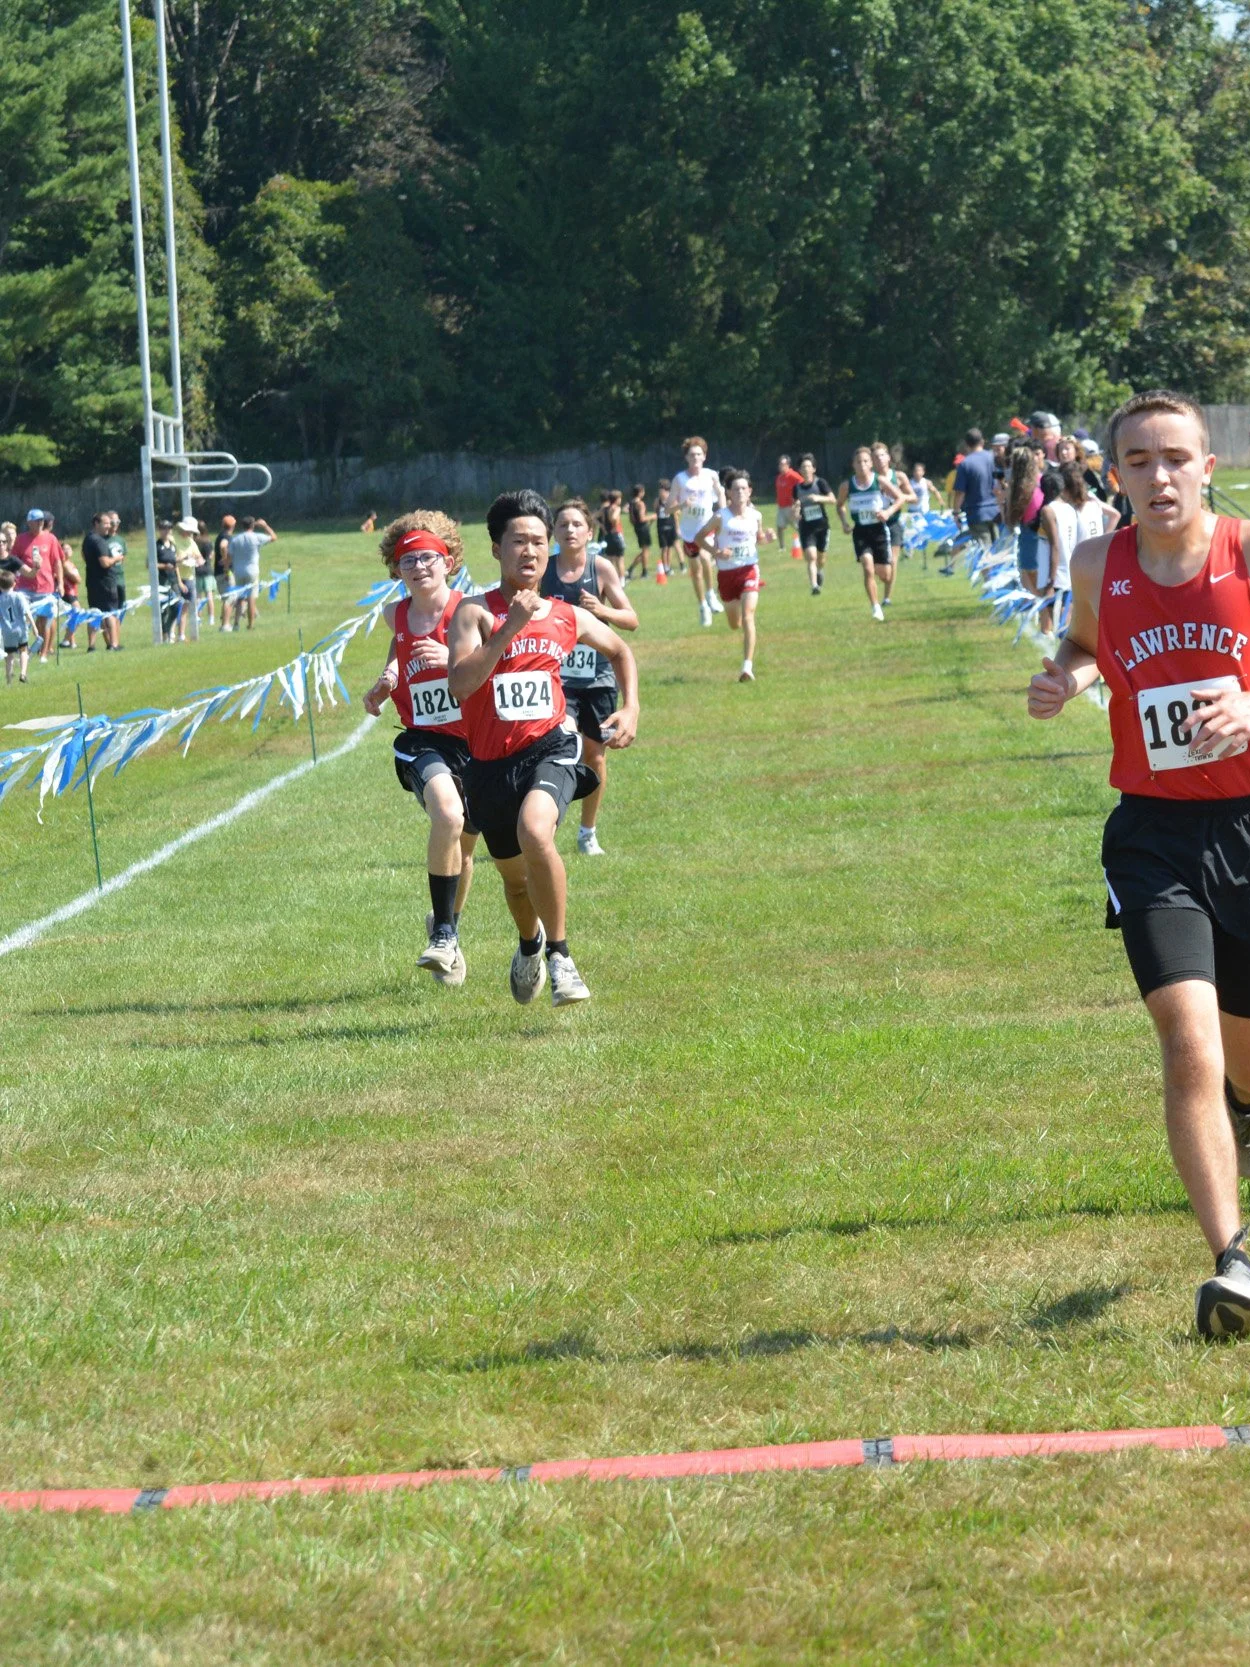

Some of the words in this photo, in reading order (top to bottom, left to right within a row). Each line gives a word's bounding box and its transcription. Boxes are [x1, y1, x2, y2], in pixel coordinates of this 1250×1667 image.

[7, 606, 14, 622] 1
[1115, 622, 1248, 672] LAWRENCE
[496, 680, 551, 709] 1824
